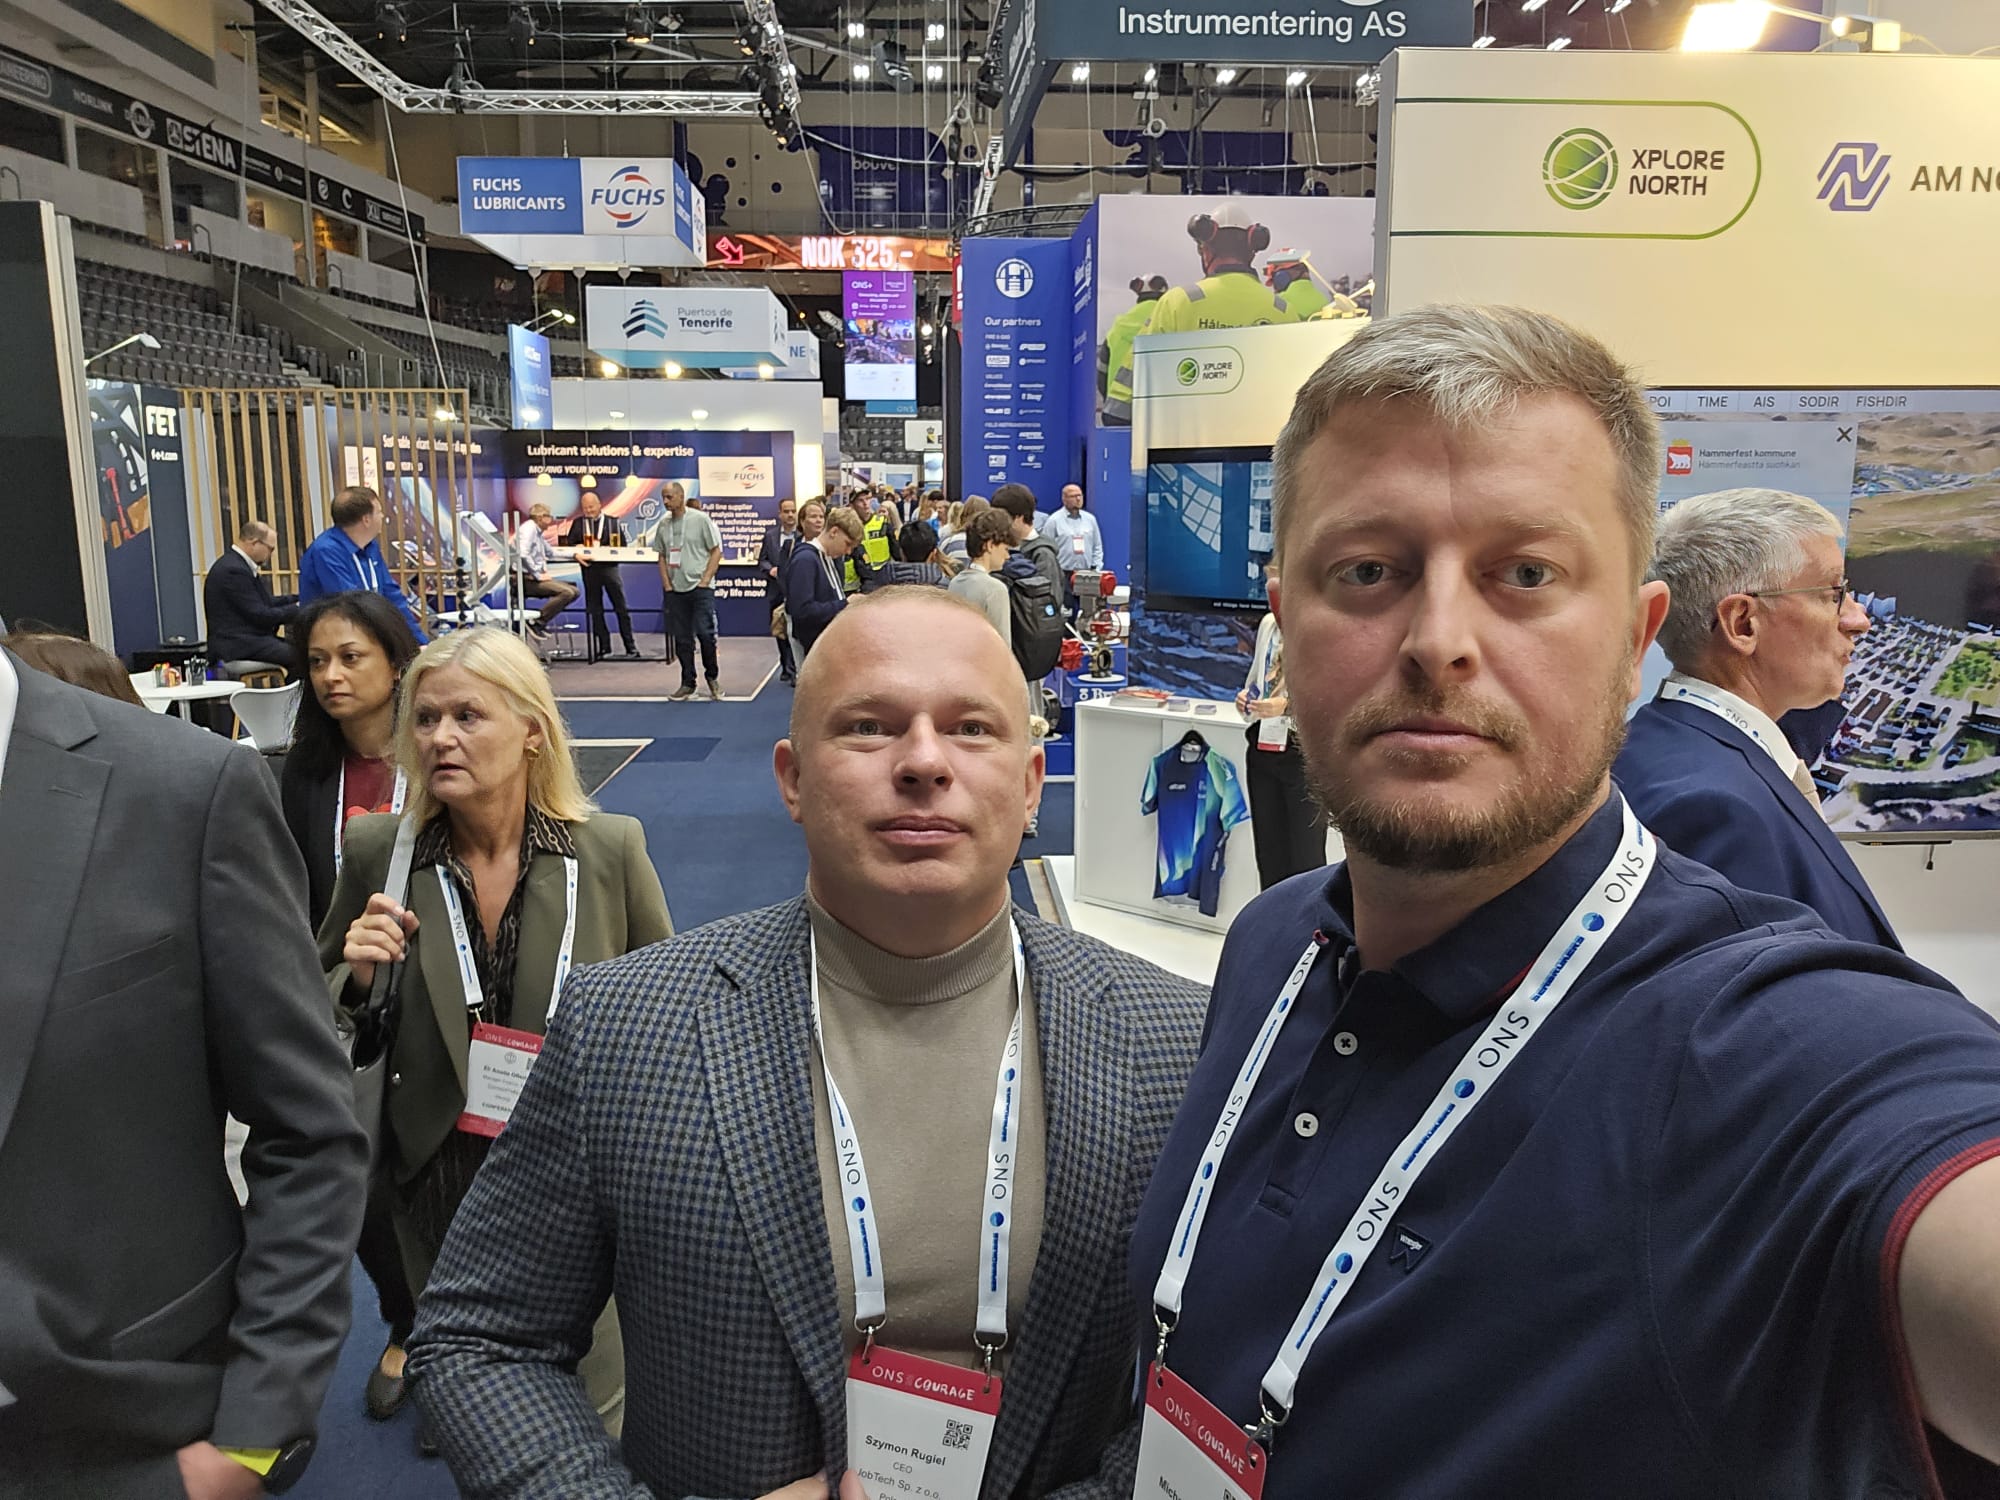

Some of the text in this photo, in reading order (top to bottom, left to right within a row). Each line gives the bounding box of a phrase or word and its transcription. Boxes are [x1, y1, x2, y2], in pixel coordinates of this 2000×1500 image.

[1118, 8, 1407, 43] Instrumentering AS
[183, 125, 237, 170] STENA
[1631, 148, 1726, 172] XPLORE
[472, 177, 522, 192] FUCHS
[1629, 174, 1709, 199] NORTH
[1909, 165, 1963, 193] AM
[473, 196, 566, 211] LUBRICANTS
[591, 188, 666, 206] FUCHS
[801, 236, 846, 268] NOK
[677, 306, 733, 317] Puertos de
[679, 317, 733, 328] Tenerife
[984, 316, 1042, 328] Our partners
[1202, 371, 1228, 381] NORTH
[1203, 361, 1233, 372] XPLORE
[1697, 395, 1729, 408] TIME
[1753, 395, 1775, 408] AIS
[1798, 395, 1840, 408] SODIR
[1855, 394, 1907, 407] FISHDIR
[527, 445, 695, 459] Lubricant solutions & expertise
[1699, 449, 1797, 458] Hammerfest kommune
[564, 466, 587, 474] YOUR
[588, 466, 619, 475] WORLD
[733, 472, 765, 481] FUCHS
[1724, 708, 1748, 729] ONS
[1604, 851, 1645, 905] ONS
[453, 914, 465, 940] ONS
[1476, 1009, 1530, 1069] ONS
[1213, 1094, 1244, 1148] ONS
[840, 1138, 861, 1186] ONS
[991, 1152, 1010, 1201] ONS
[1356, 1180, 1401, 1242] ONS
[872, 1366, 976, 1401] ONS COURAGE
[1165, 1397, 1245, 1475] ONS COURAGE
[864, 1435, 946, 1466] Szymon Rugiel
[892, 1461, 913, 1474] CEO
[857, 1467, 941, 1500] JobTech Sp. z o.o.
